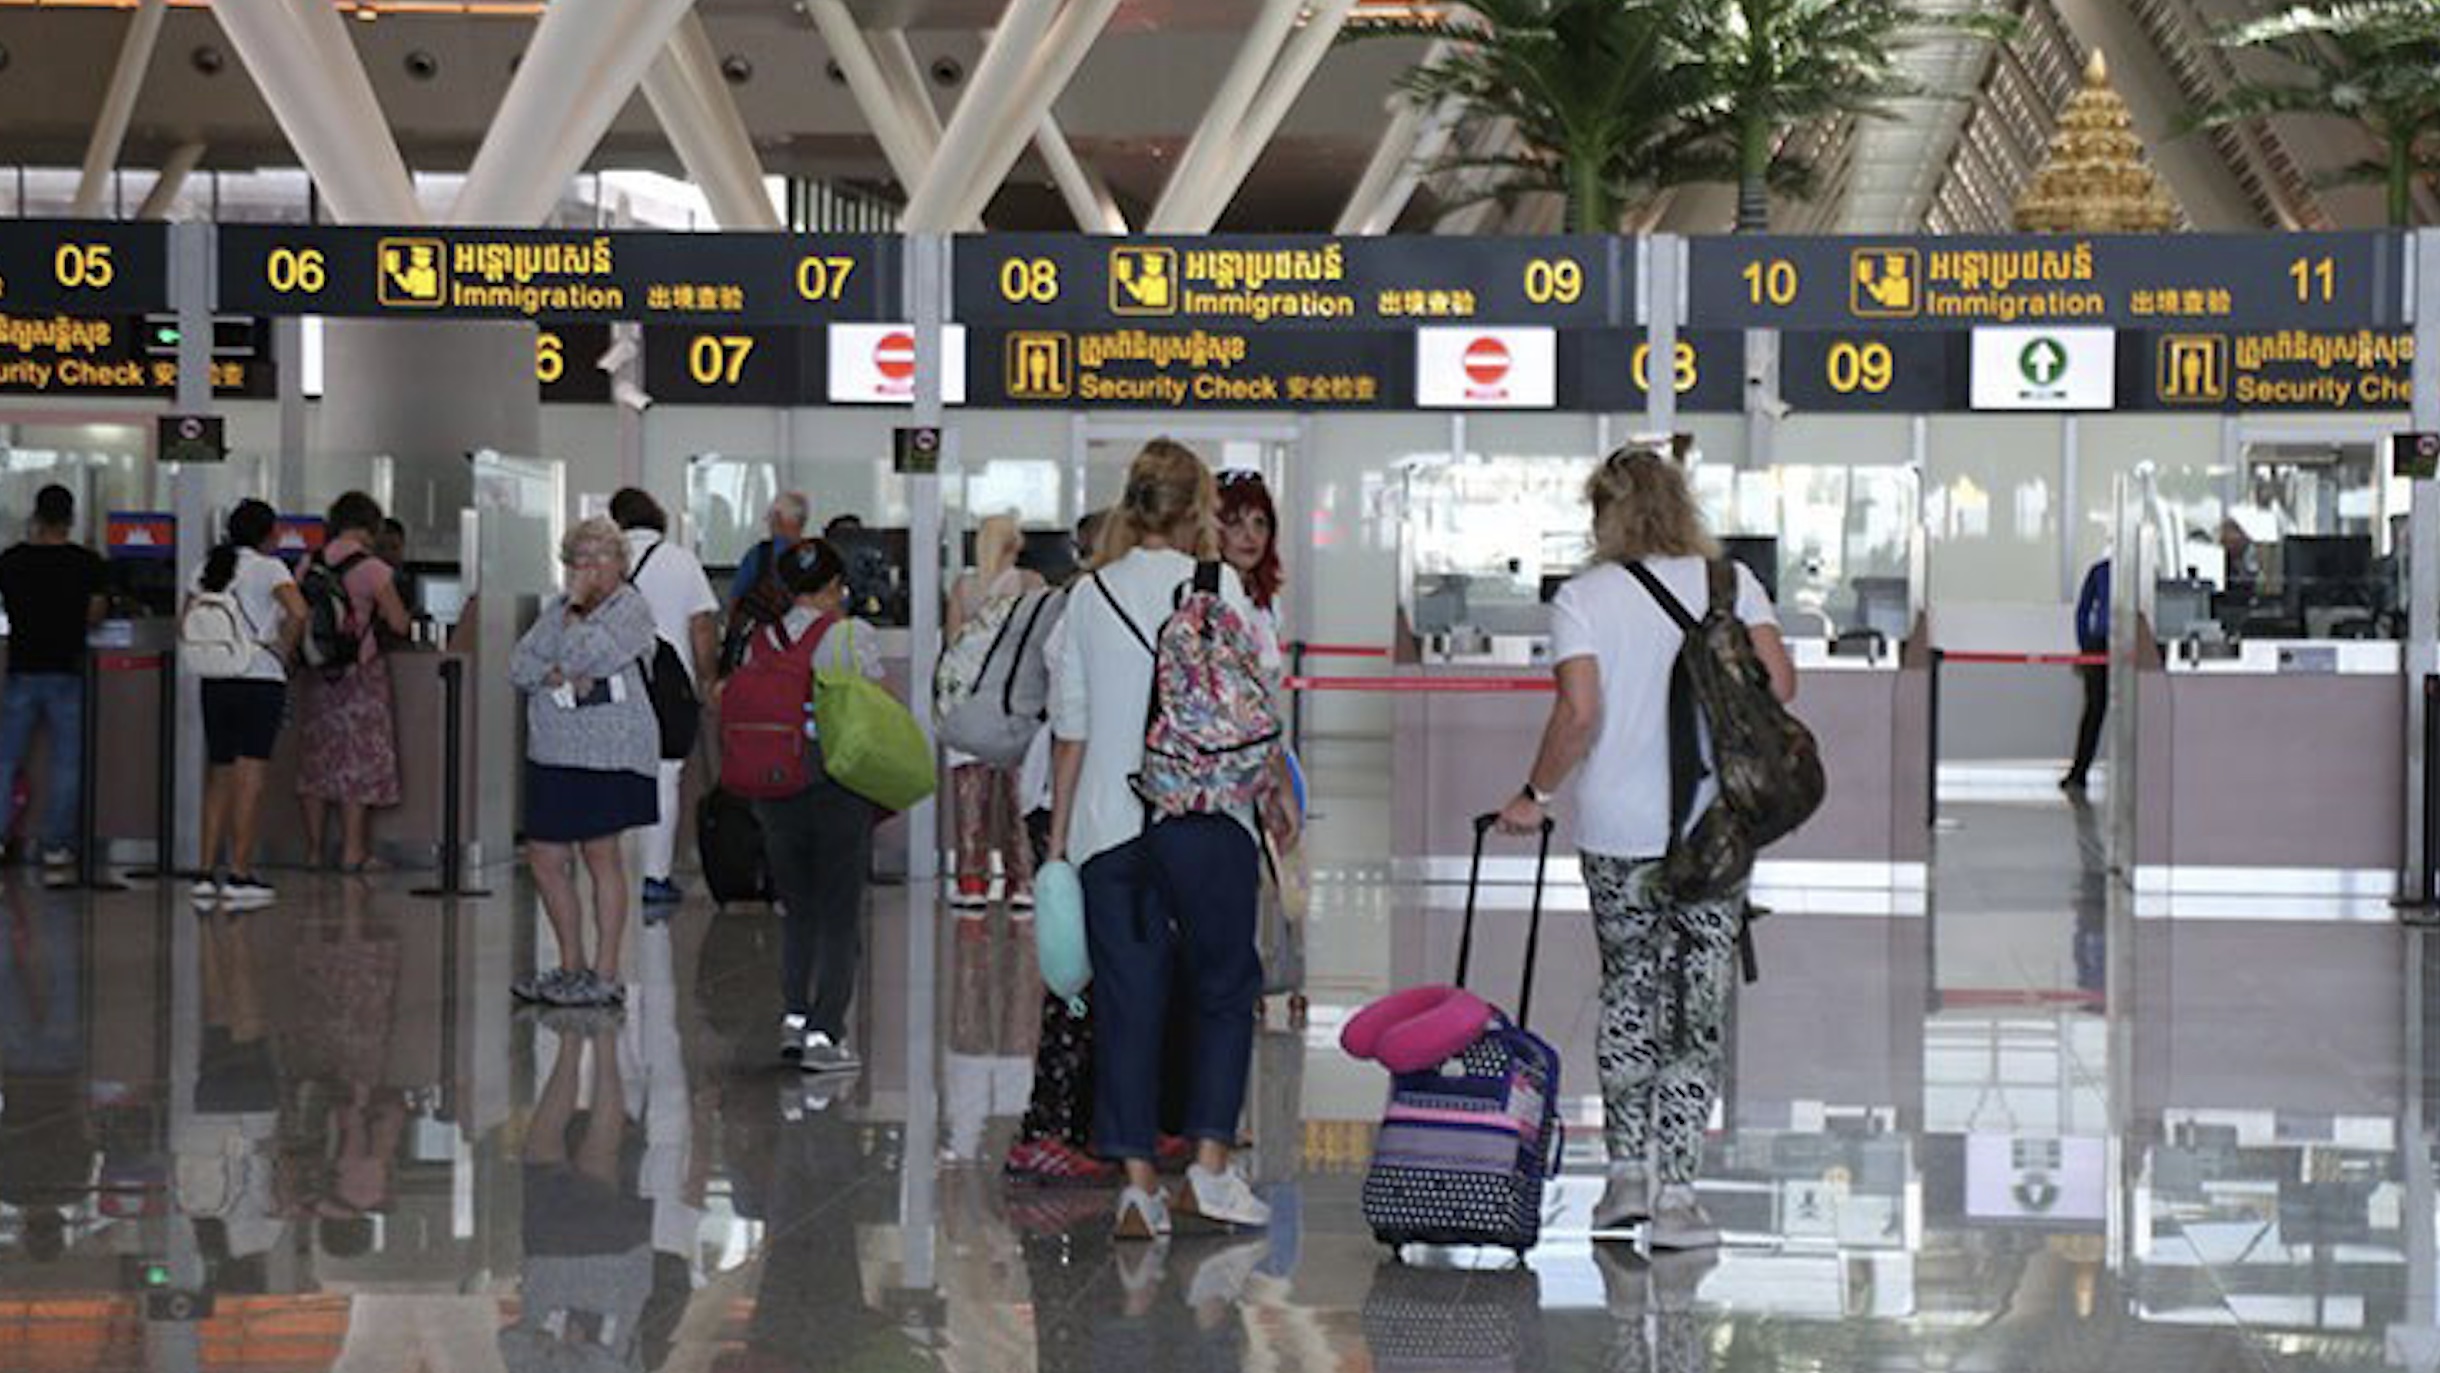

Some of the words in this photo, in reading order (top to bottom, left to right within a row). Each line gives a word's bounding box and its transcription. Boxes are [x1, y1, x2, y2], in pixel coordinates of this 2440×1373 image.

[55, 244, 113, 287] 05
[267, 250, 325, 293] 06
[796, 256, 855, 300] 07
[1000, 258, 1059, 302] 08
[1523, 259, 1583, 303] 09
[1742, 259, 1798, 304] 10
[2289, 257, 2334, 302] 11
[453, 280, 623, 315] Immigration
[1184, 289, 1354, 320] Immigration
[1925, 289, 2105, 321] Immigration
[57, 359, 144, 386] Check
[689, 336, 754, 384] 07
[1827, 341, 1893, 393] 09
[1079, 372, 1188, 405] Security
[1192, 373, 1278, 399] Check
[2236, 375, 2351, 406] Security
